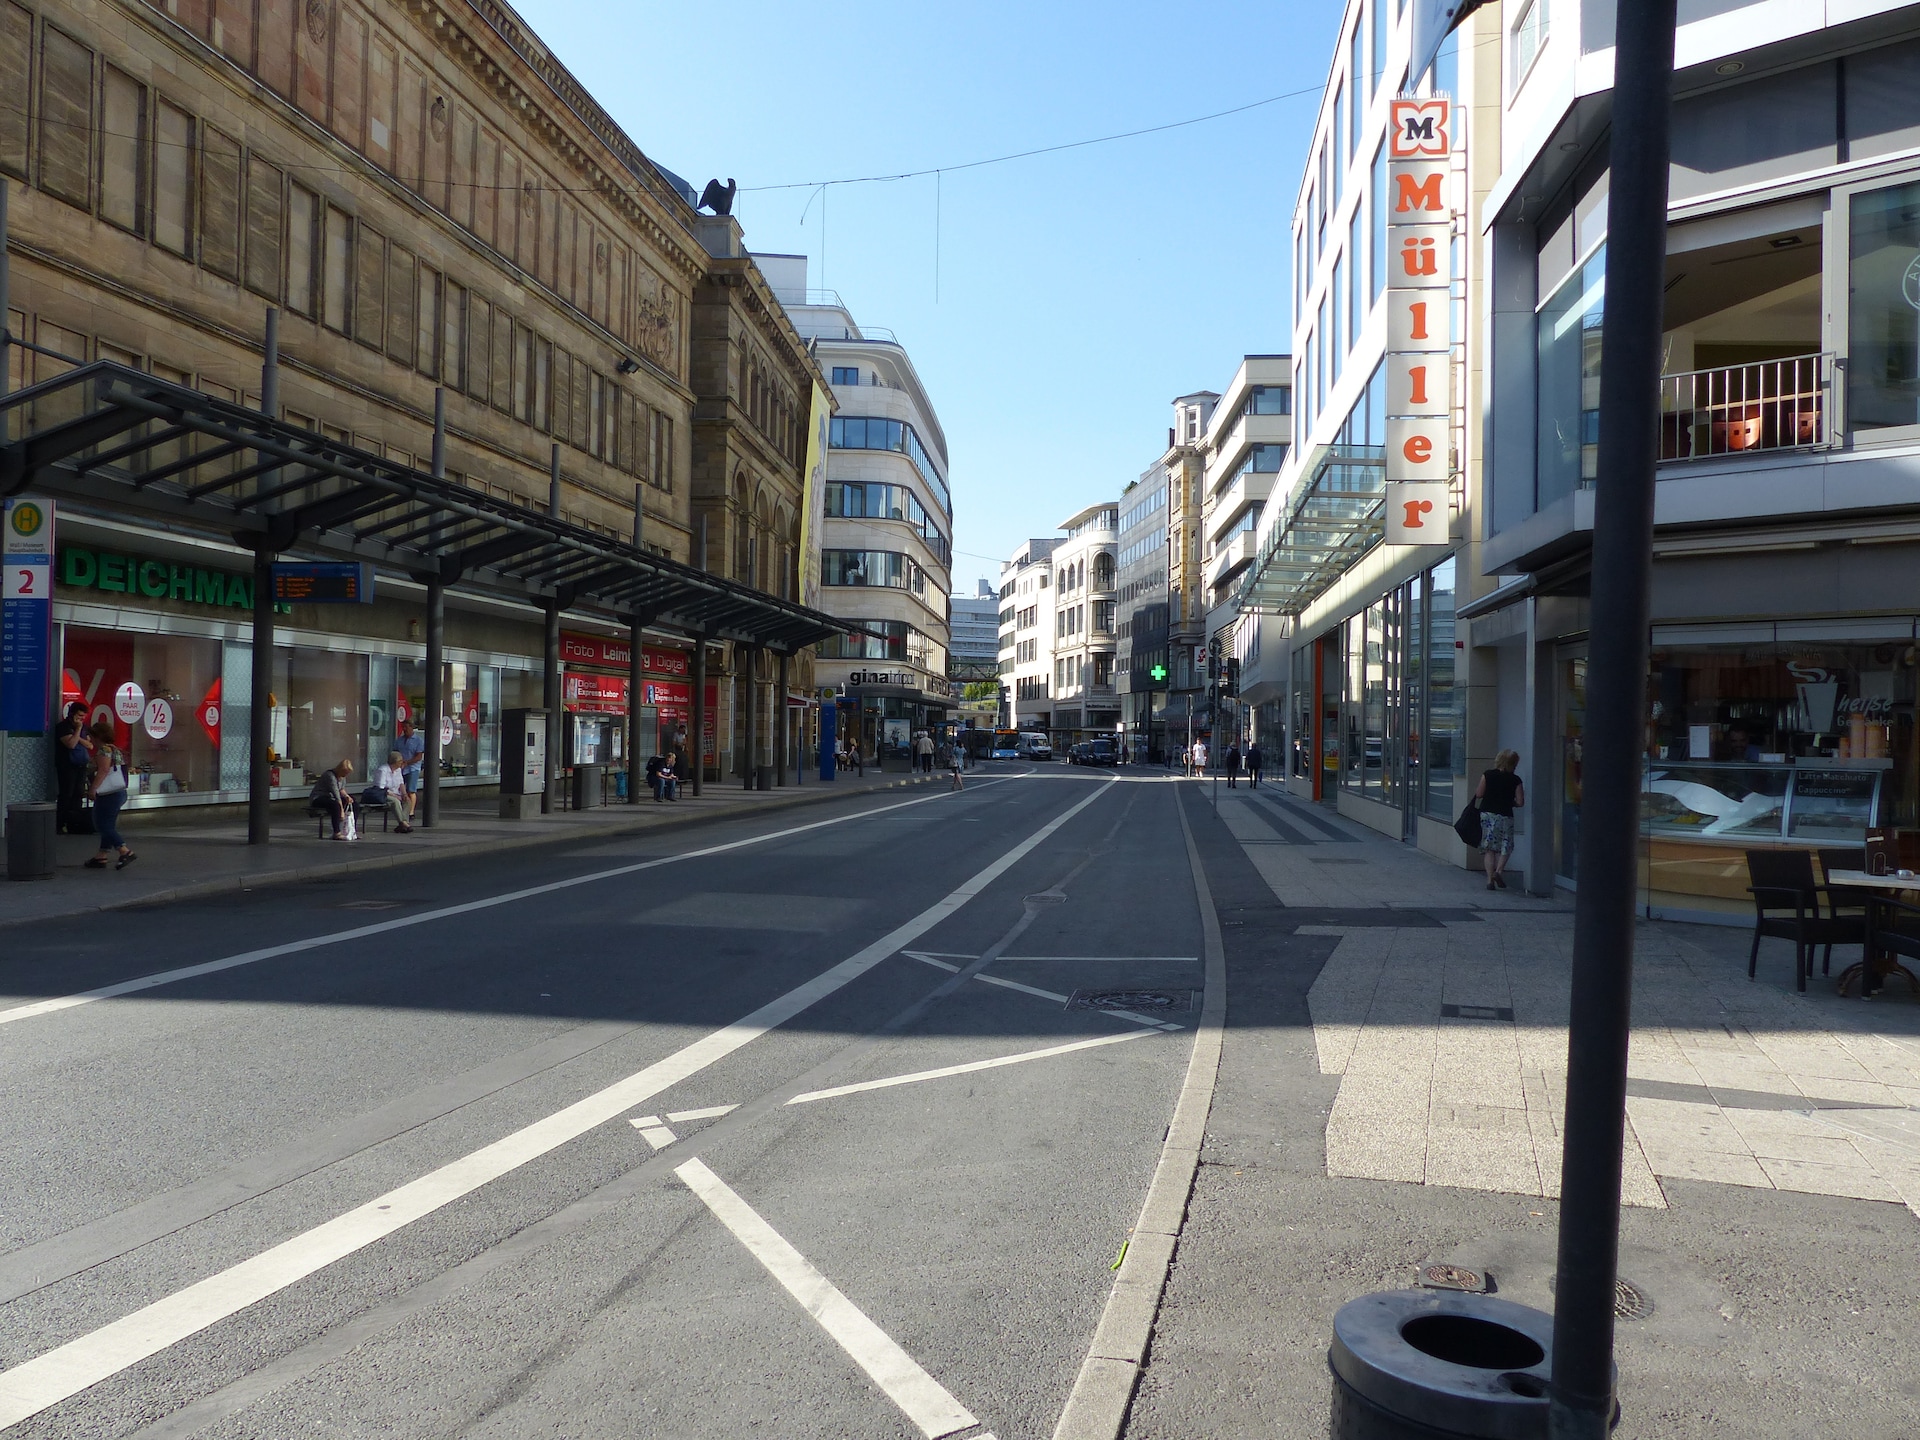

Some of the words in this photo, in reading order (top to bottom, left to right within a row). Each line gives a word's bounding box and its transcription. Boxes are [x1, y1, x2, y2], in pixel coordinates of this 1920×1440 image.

[1405, 117, 1434, 140] M
[1395, 173, 1445, 528] Müller
[18, 570, 34, 594] 2
[565, 641, 594, 658] Foto
[656, 655, 685, 671] Digital
[126, 686, 133, 700] 1
[577, 679, 597, 689] Digital
[577, 688, 602, 698] Express
[602, 689, 619, 698] Labor
[655, 694, 673, 702] Express
[1836, 694, 1893, 716] heiße
